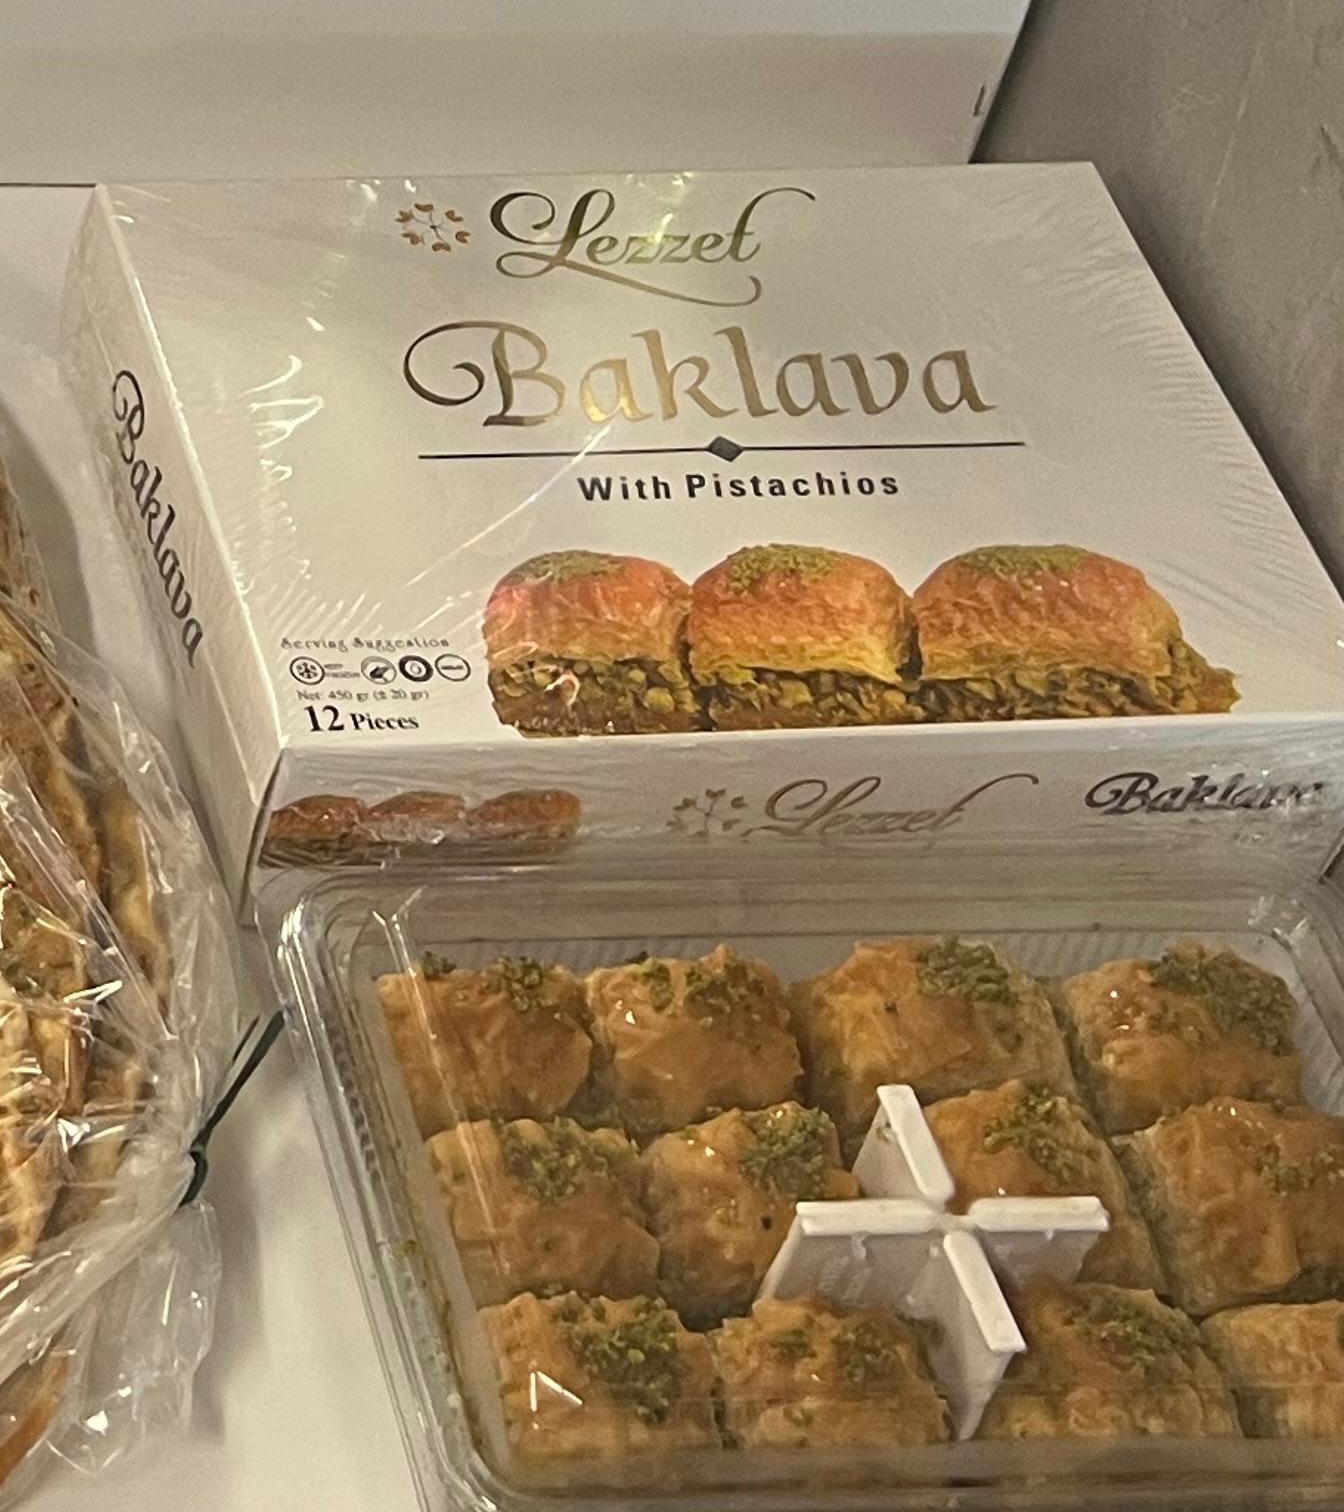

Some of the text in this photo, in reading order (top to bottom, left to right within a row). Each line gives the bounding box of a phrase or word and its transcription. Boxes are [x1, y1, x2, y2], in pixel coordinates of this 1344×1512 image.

[489, 187, 816, 307] Lezzet
[403, 320, 998, 429] Baklava
[112, 369, 204, 669] Baklava
[577, 471, 900, 503] With Pistachios
[280, 636, 451, 654] Serving Suggestion
[304, 704, 420, 733] 12 Pieces
